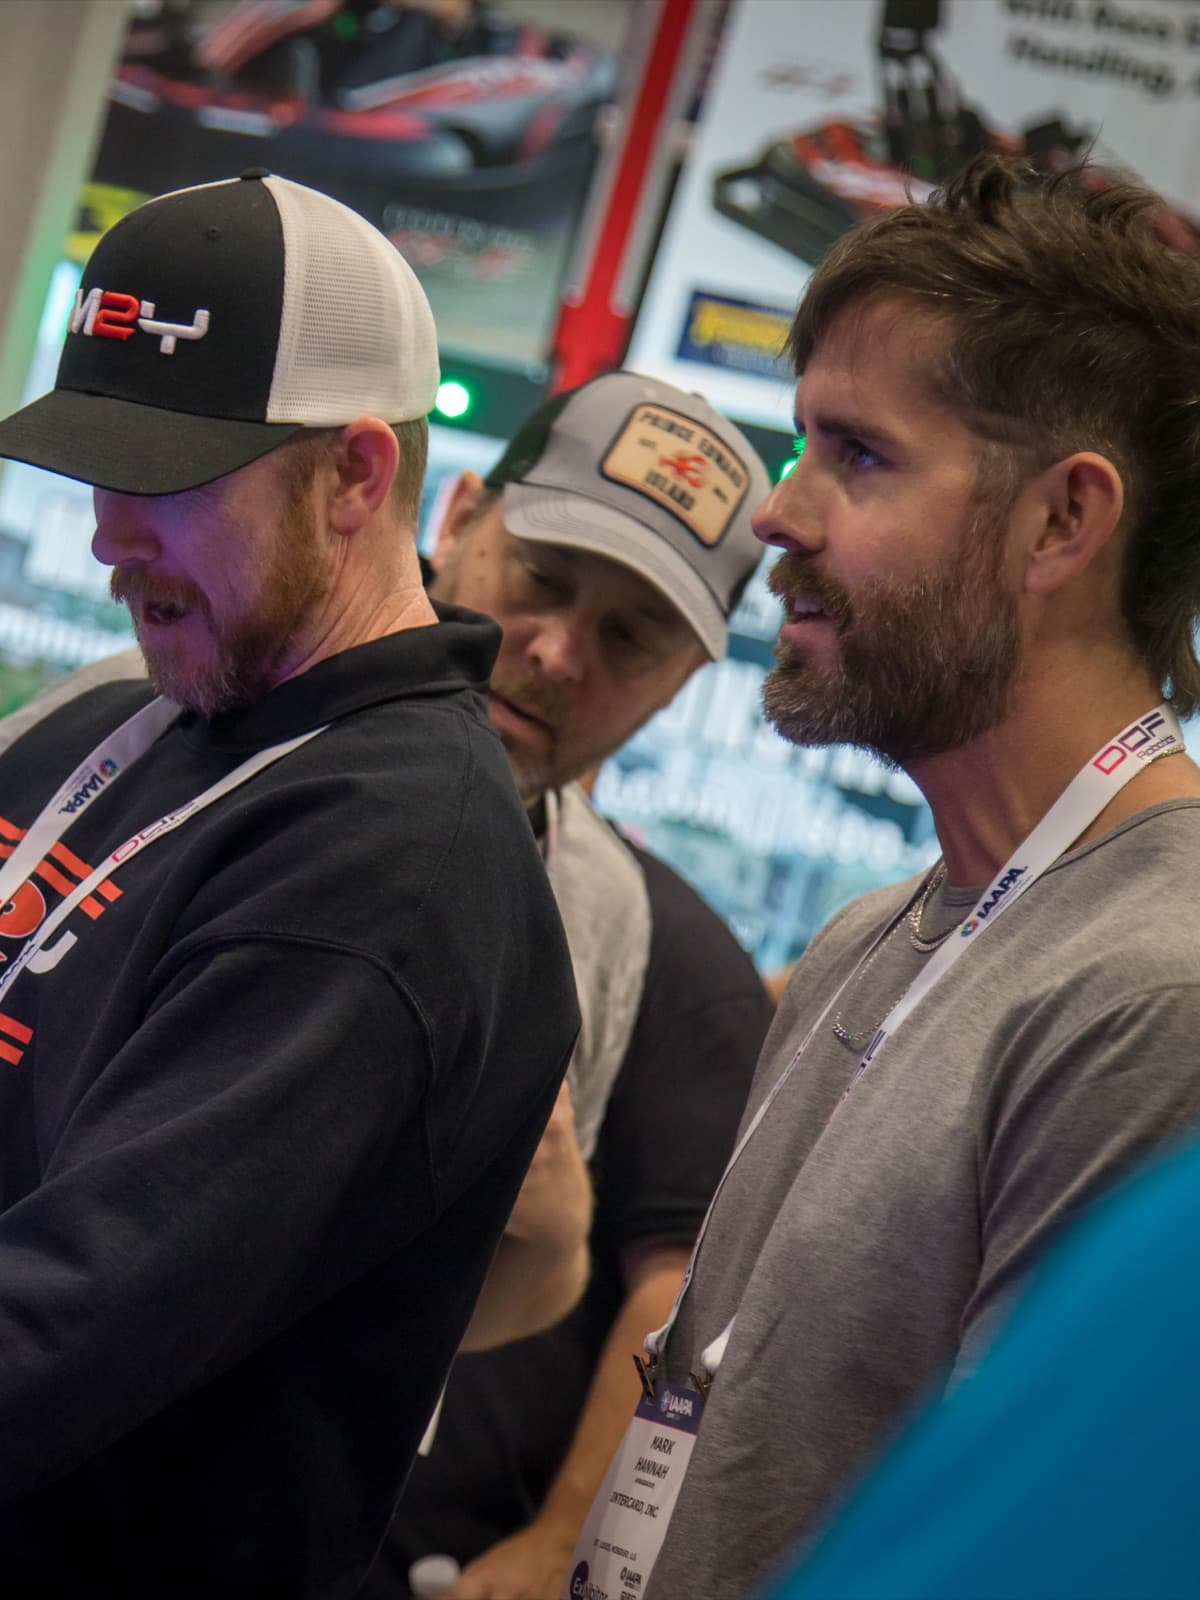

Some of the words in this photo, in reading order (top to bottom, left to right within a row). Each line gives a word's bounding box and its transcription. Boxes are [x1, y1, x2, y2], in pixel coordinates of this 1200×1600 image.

[60, 776, 105, 815] IAAPA
[976, 866, 1027, 920] IAAPA
[669, 1395, 693, 1417] IAAPA
[650, 1435, 676, 1456] MARK
[634, 1456, 671, 1480] HANNAH
